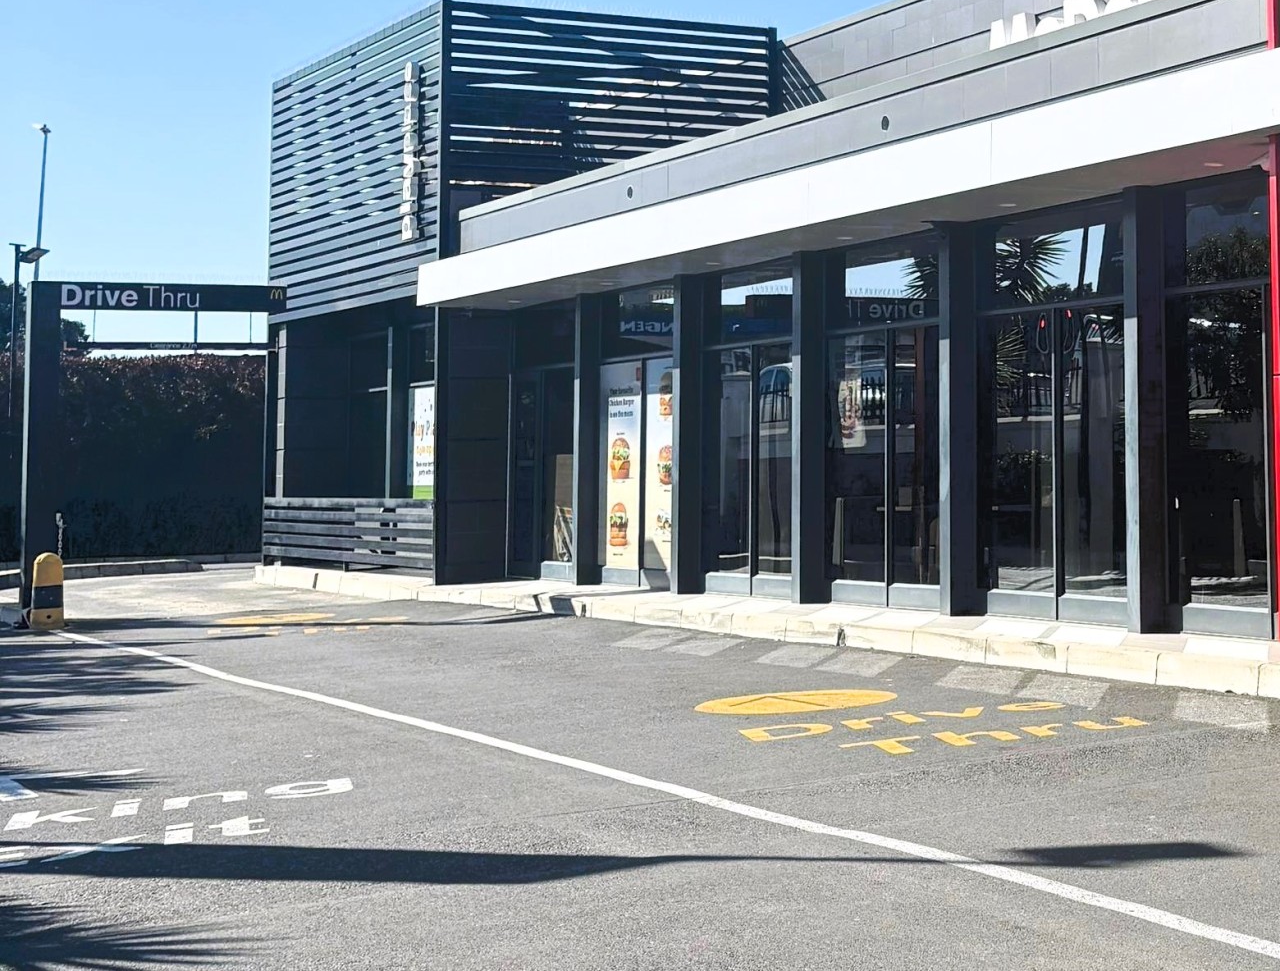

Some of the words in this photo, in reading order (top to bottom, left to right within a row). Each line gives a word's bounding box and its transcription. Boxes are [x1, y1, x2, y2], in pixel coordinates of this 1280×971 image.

[61, 284, 138, 307] Drive
[143, 285, 200, 308] Thru
[738, 701, 1066, 742] Drive
[839, 716, 1149, 754] Thru
